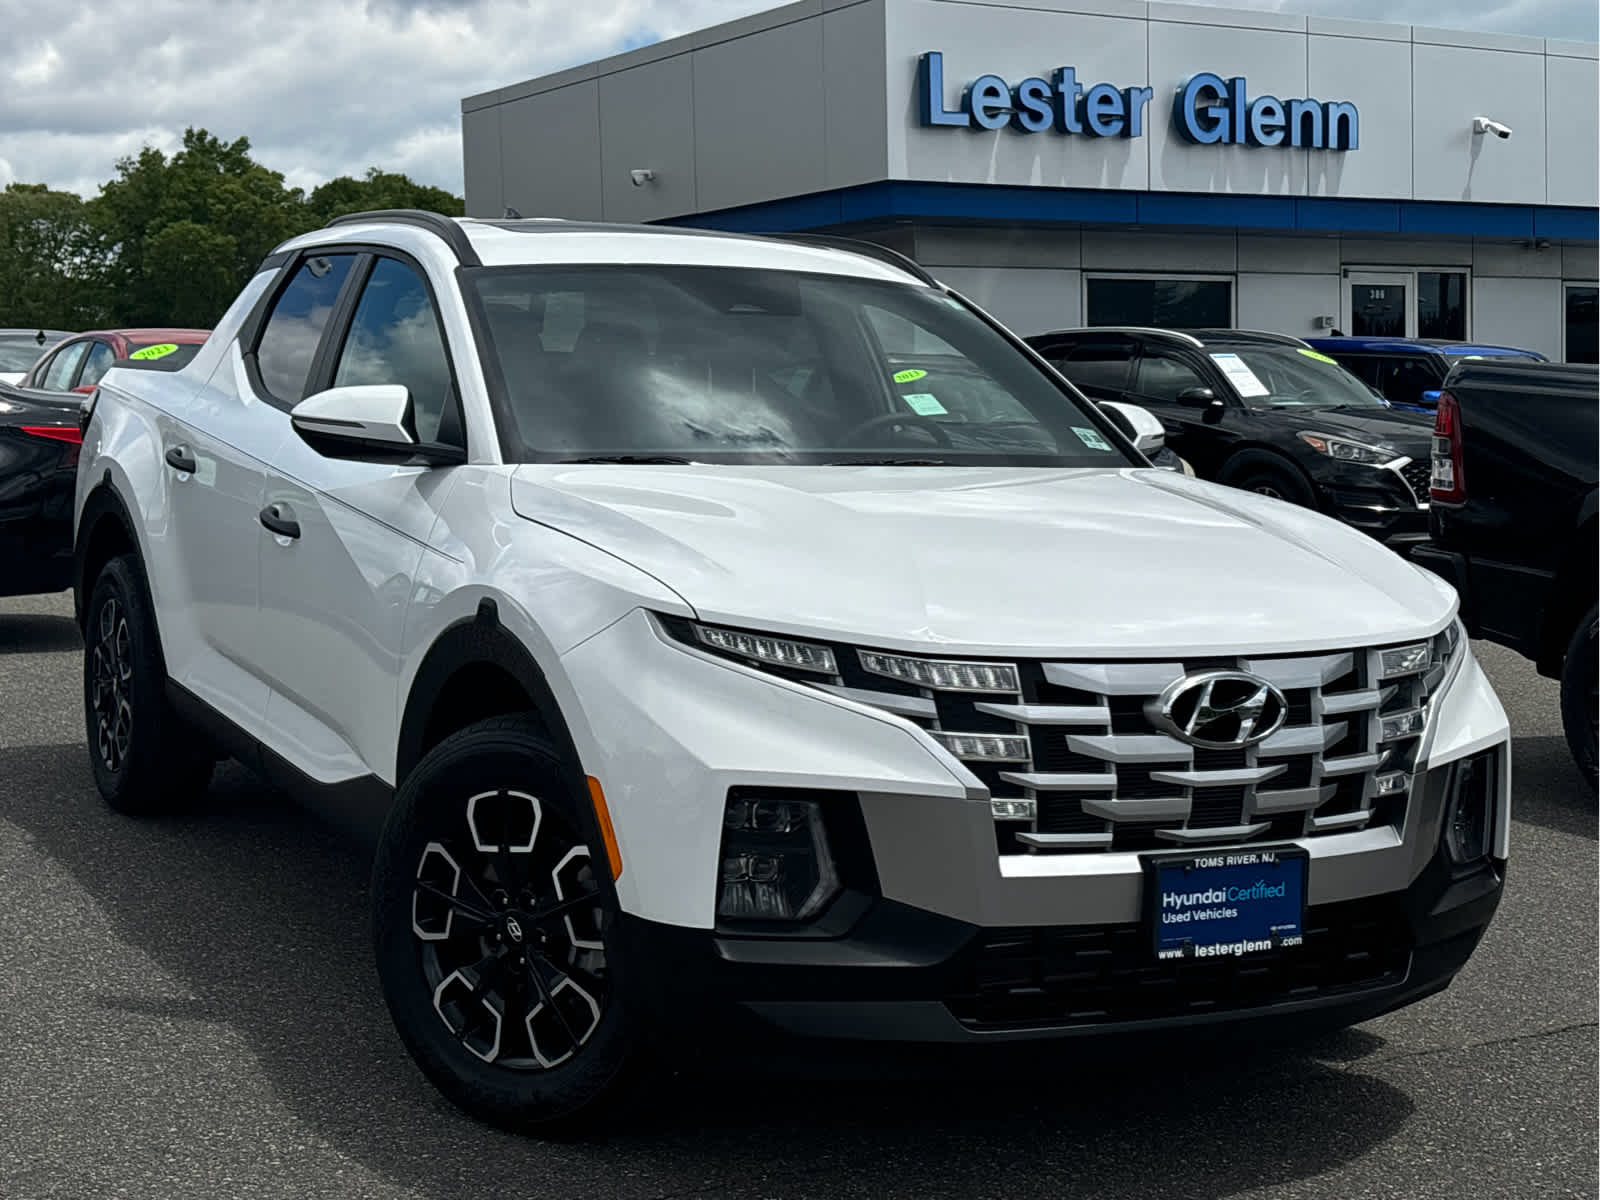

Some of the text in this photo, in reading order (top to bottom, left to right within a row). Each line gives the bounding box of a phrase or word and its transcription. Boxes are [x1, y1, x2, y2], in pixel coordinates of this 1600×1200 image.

[919, 51, 1360, 151] Lester Glenn
[1194, 858, 1224, 868] TOMS
[1162, 880, 1285, 909] Hyundai Certified
[1162, 908, 1238, 923] Used Vehicles
